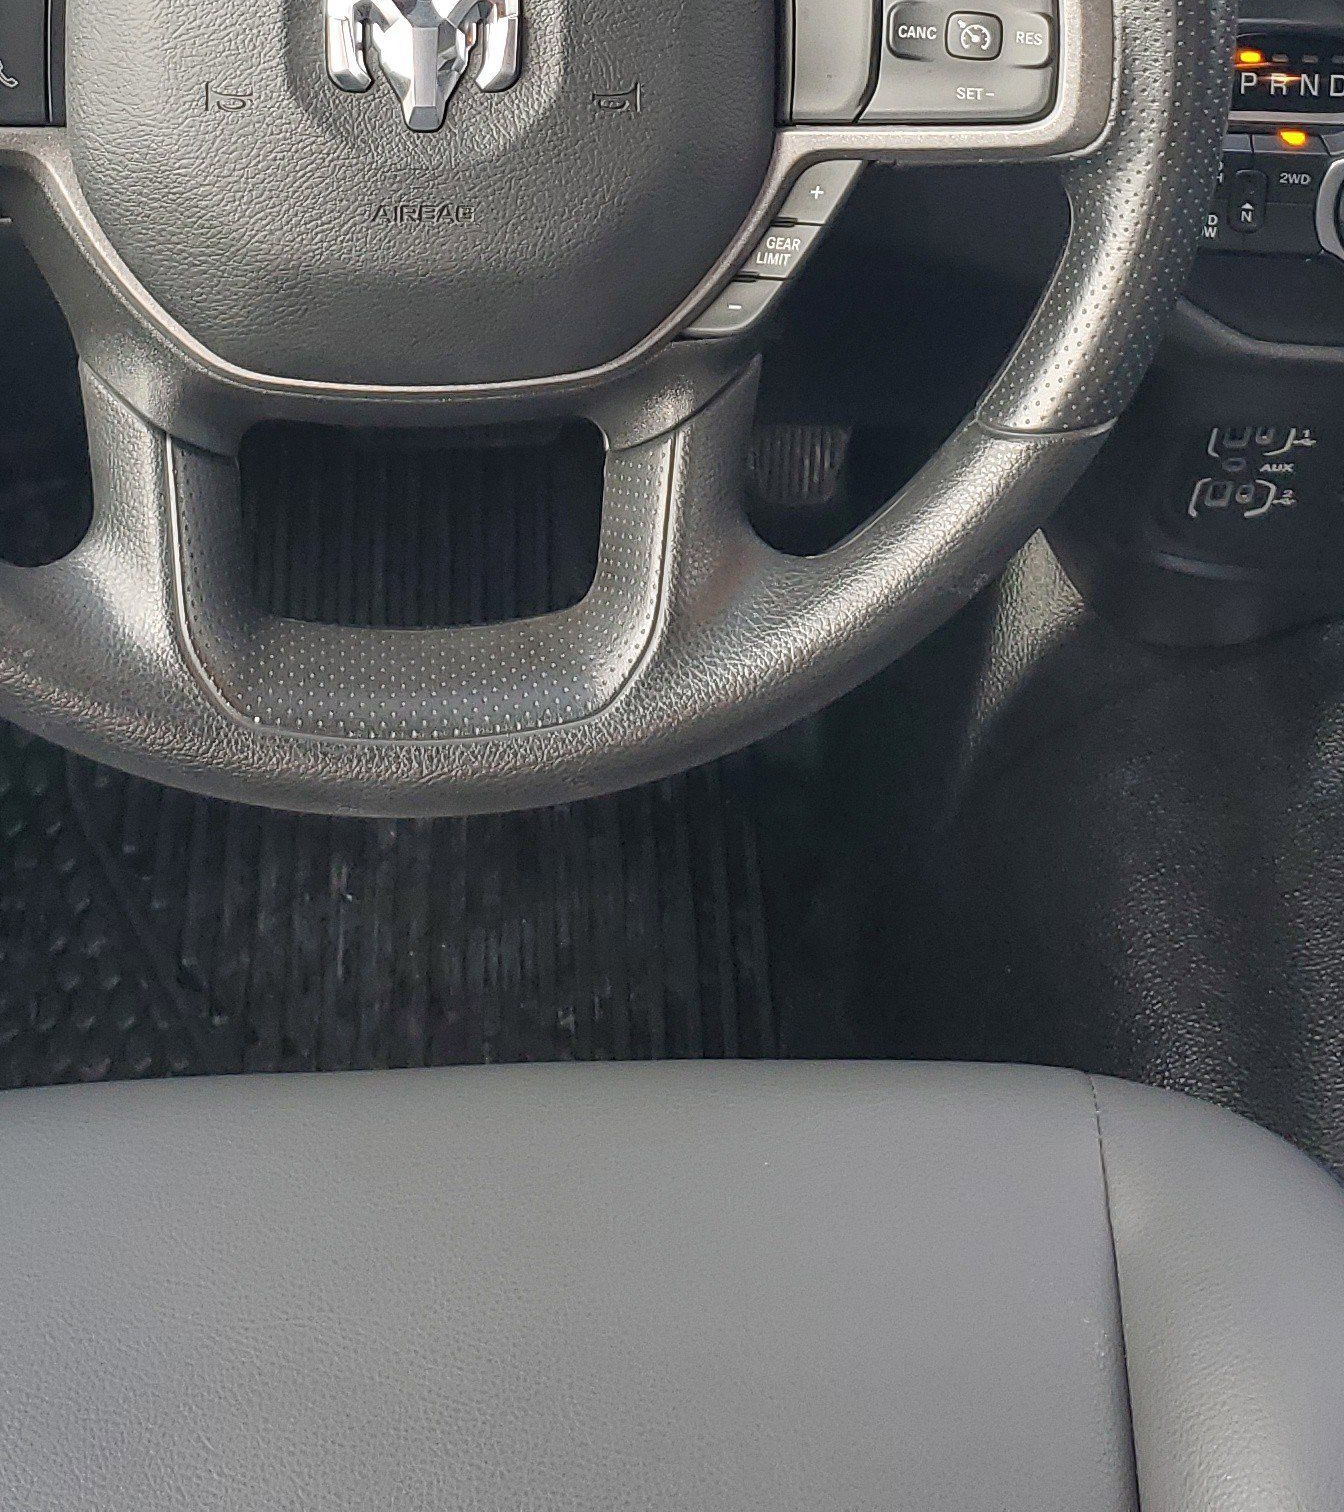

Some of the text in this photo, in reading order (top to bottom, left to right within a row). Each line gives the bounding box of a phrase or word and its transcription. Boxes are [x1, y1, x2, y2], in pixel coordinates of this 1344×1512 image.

[897, 24, 938, 41] CANC
[1015, 30, 1044, 47] RES
[1240, 71, 1258, 95] P
[1269, 73, 1288, 96] R
[1299, 72, 1320, 97] N
[1279, 172, 1312, 186] 2WD
[1240, 210, 1253, 223] N
[765, 236, 802, 252] GEAR
[755, 251, 792, 267] LIMIT
[1302, 429, 1310, 438] 1
[1259, 462, 1295, 473] AUX
